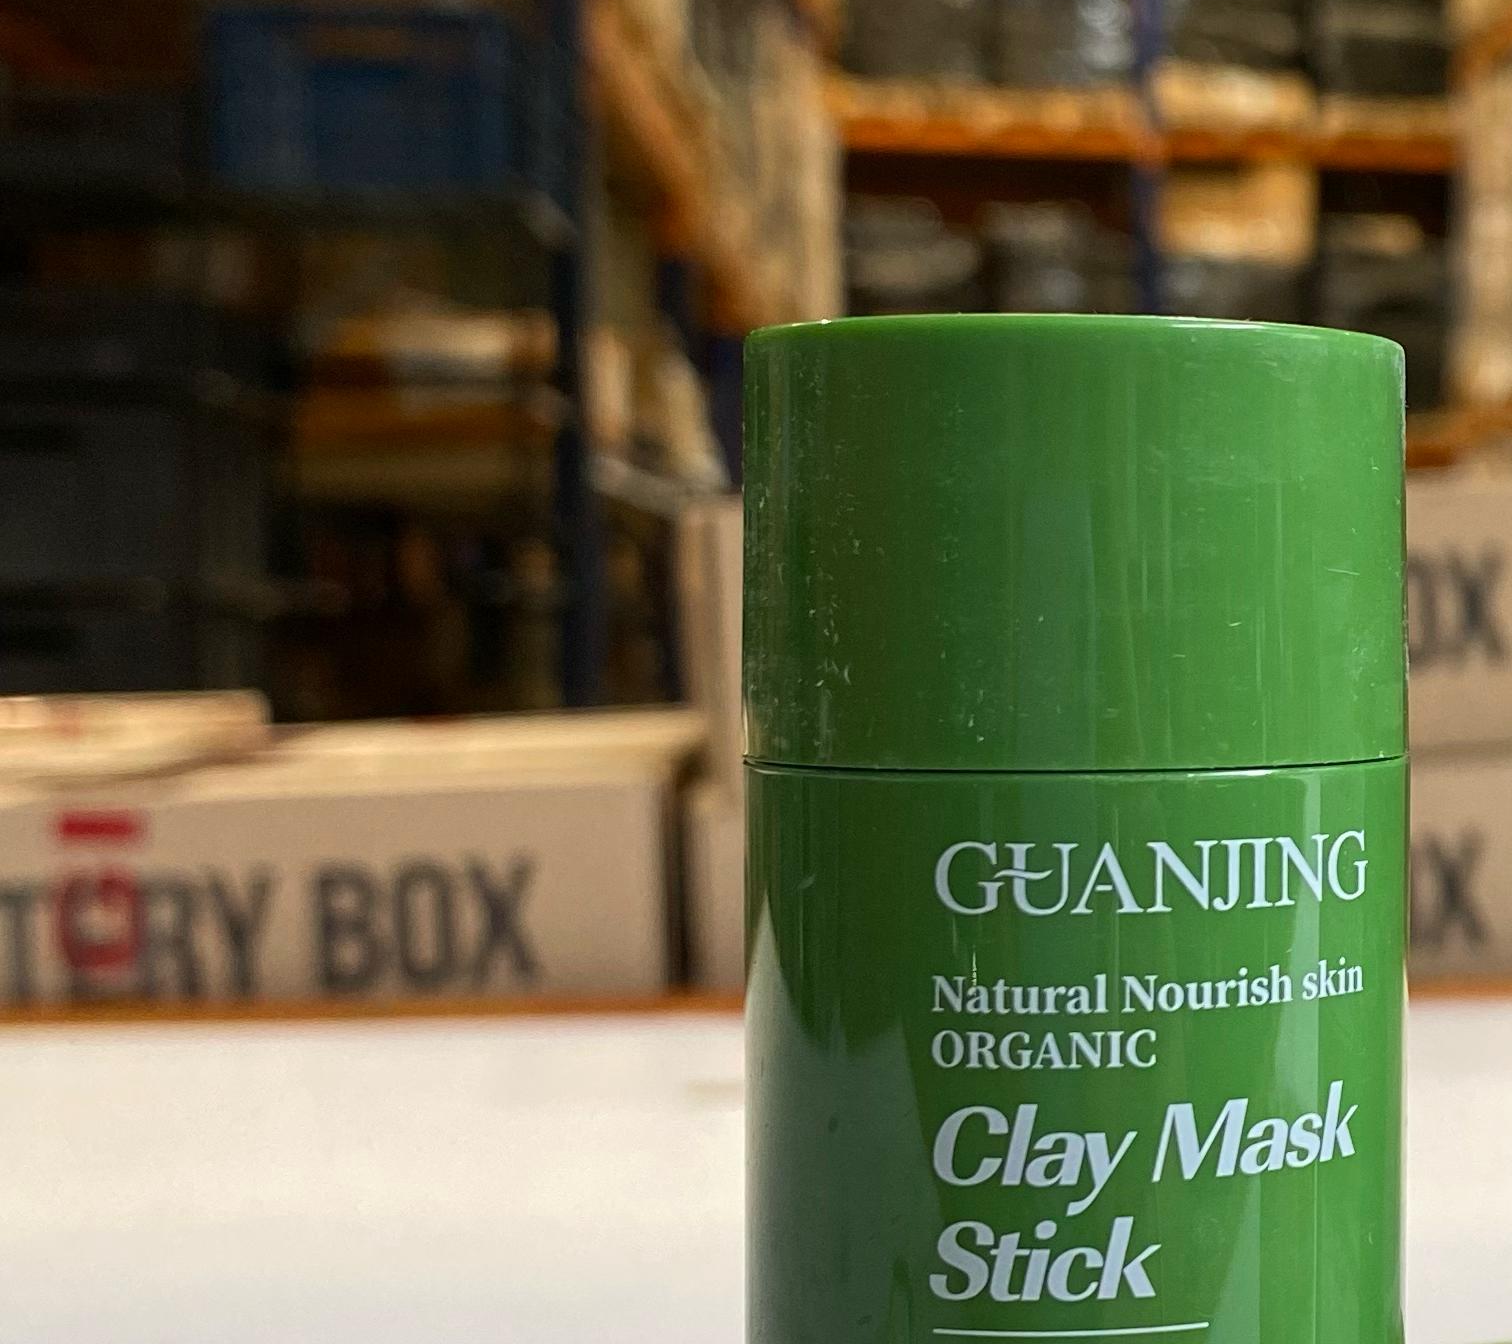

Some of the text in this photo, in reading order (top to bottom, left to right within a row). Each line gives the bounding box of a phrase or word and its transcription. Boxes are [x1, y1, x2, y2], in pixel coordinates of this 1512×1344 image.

[934, 830, 1369, 916] GUANJING
[312, 852, 539, 993] BOX
[932, 956, 1364, 1016] Natural Nourish skin
[932, 1028, 1157, 1069] ORGANIC
[933, 1080, 1358, 1216] Clay Mask
[929, 1216, 1161, 1302] Stick
